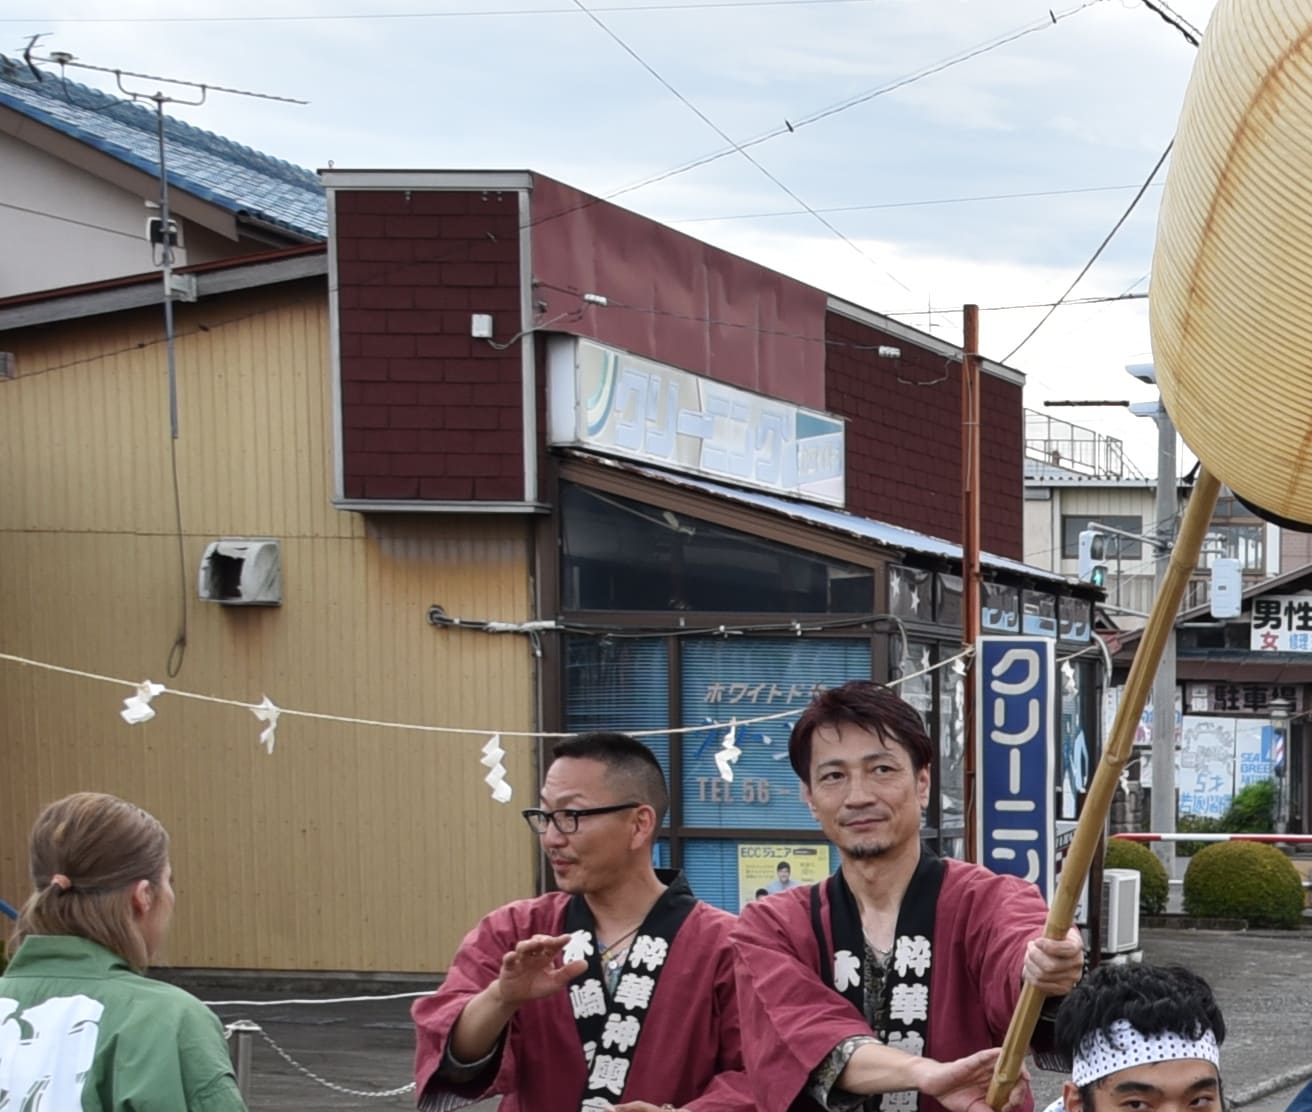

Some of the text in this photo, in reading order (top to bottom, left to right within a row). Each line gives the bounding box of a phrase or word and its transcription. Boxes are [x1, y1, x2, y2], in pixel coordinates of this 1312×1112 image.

[615, 369, 799, 488] クリーニング
[1261, 632, 1279, 650] 女
